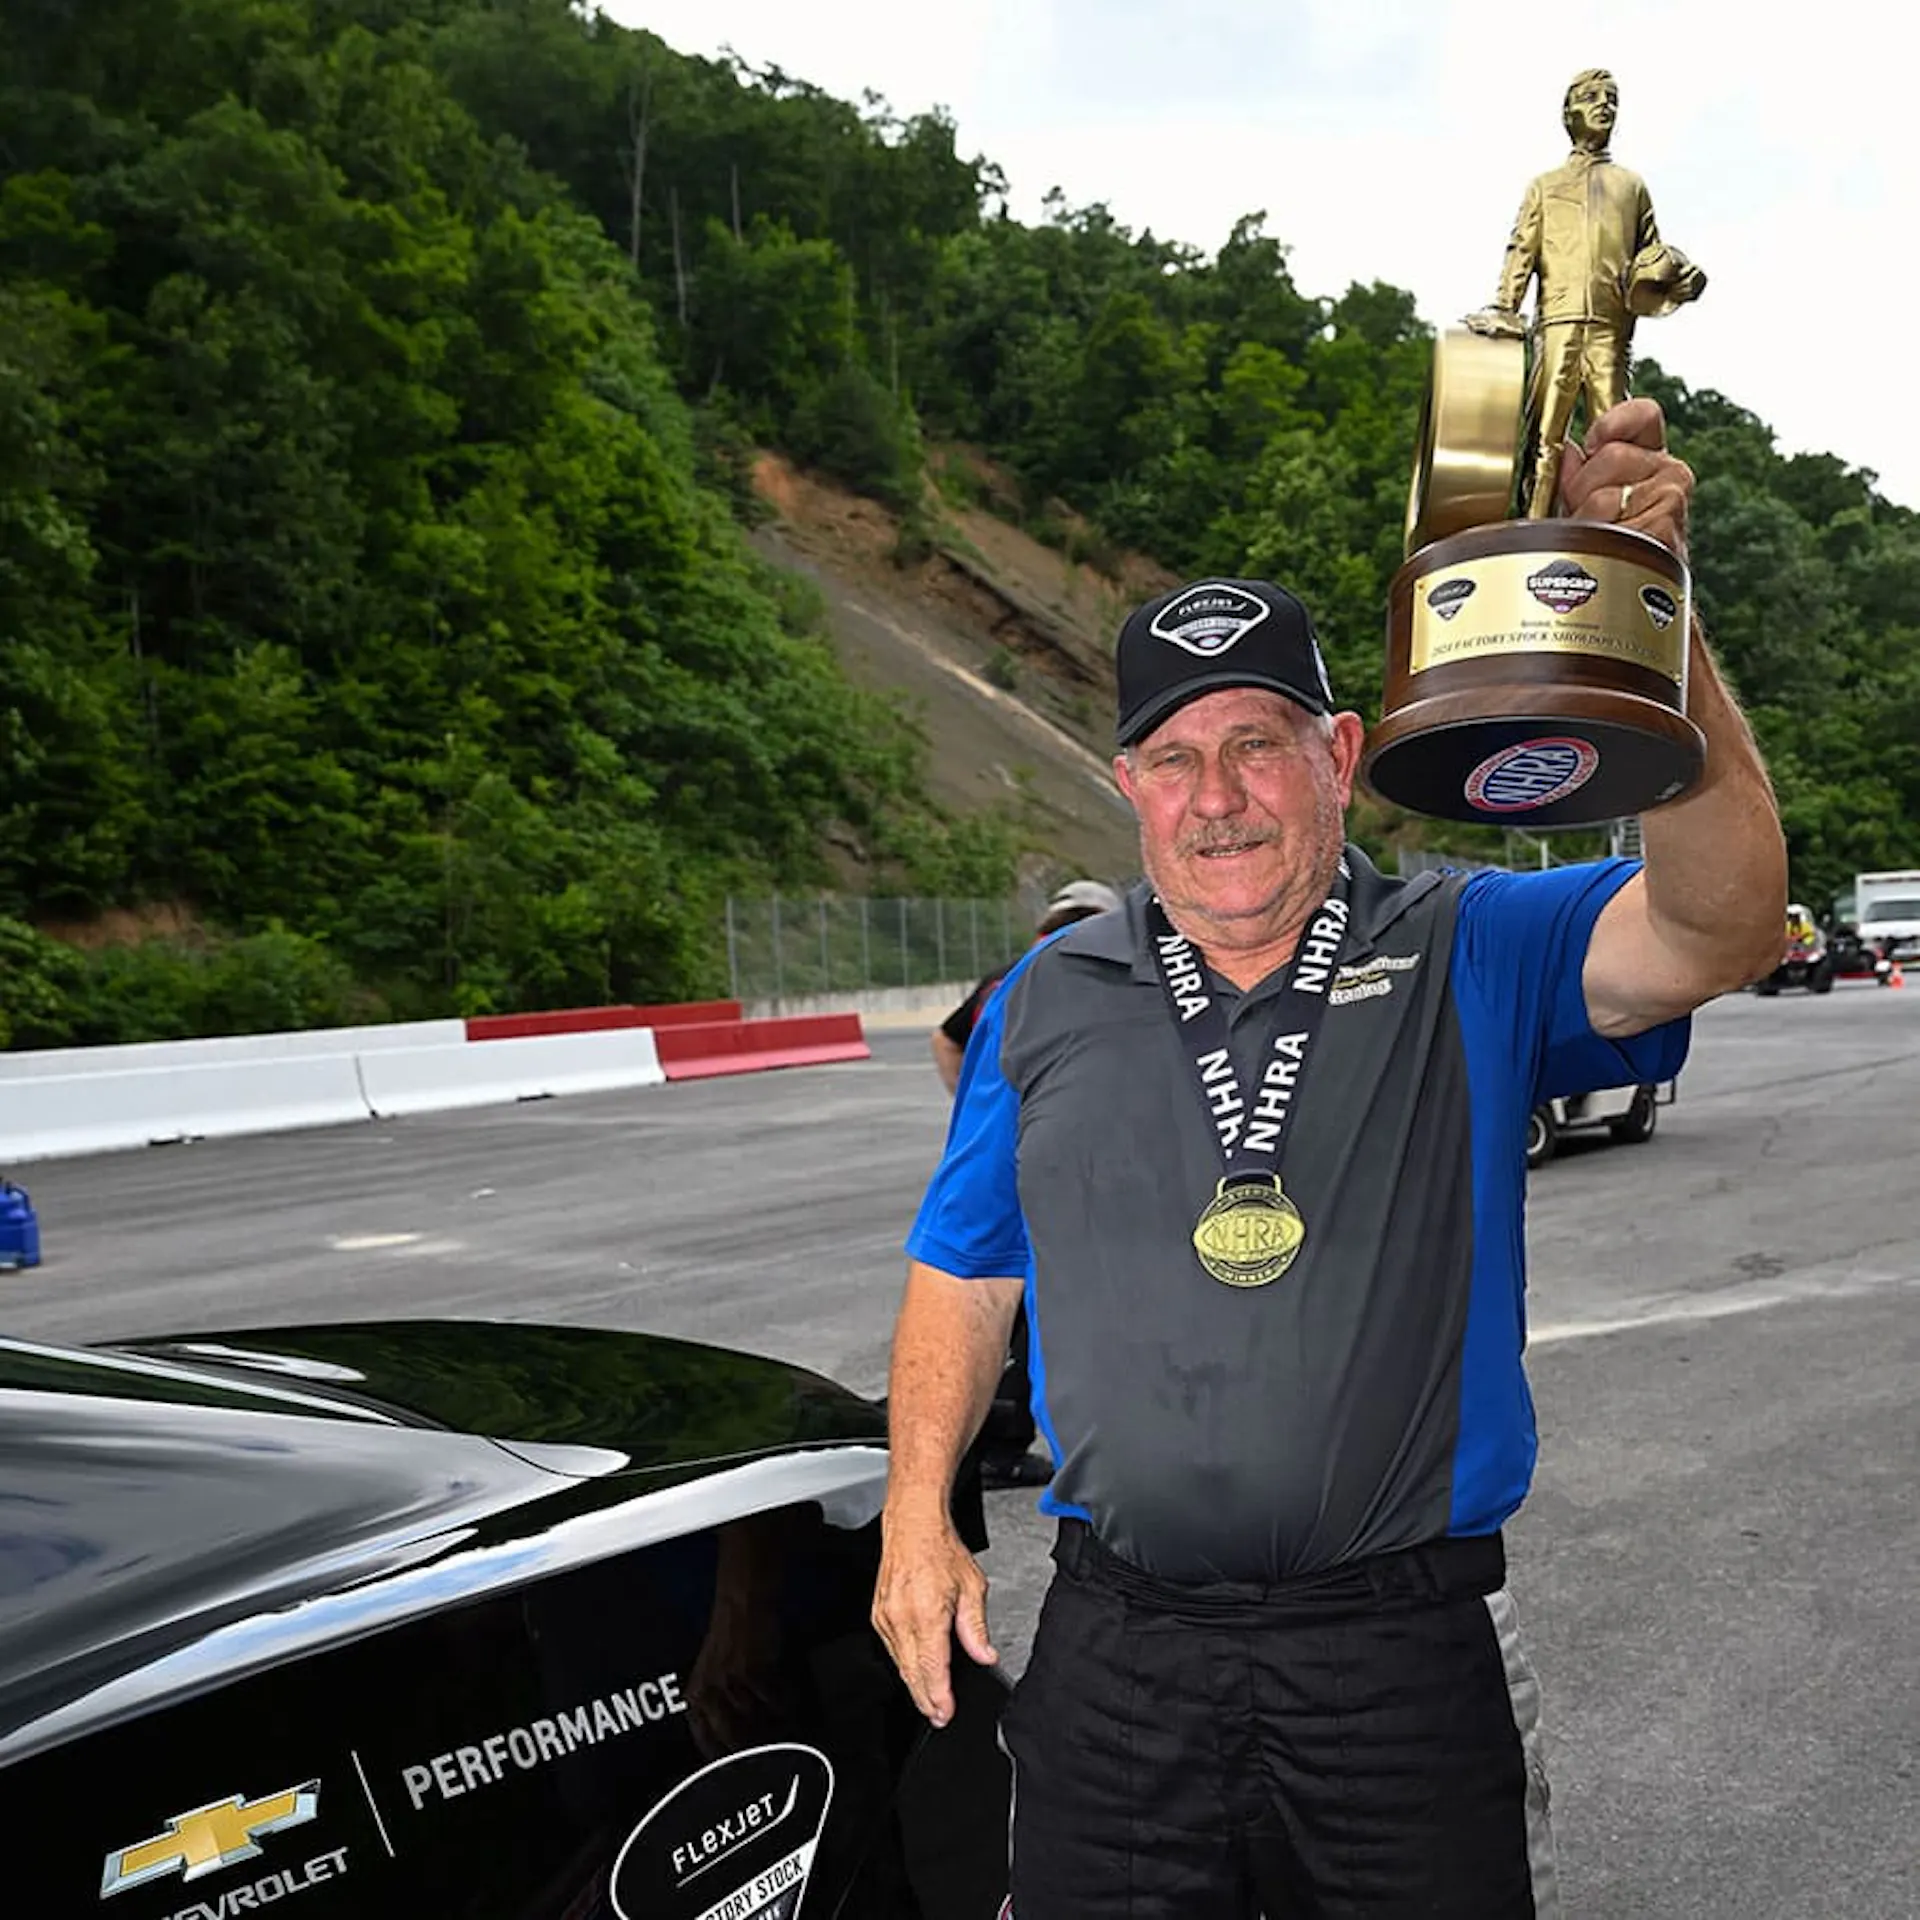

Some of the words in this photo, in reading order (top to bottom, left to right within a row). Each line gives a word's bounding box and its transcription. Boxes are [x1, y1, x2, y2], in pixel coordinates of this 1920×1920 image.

[1485, 749, 1577, 802] NHRA
[1157, 934, 1210, 1022] NHRA
[1293, 899, 1349, 993] NHRA
[1243, 1030, 1309, 1153] NHRA
[1211, 1217, 1283, 1250] NHRA
[402, 1672, 688, 1810] PERFORMANCE
[757, 1854, 803, 1900] STOCK
